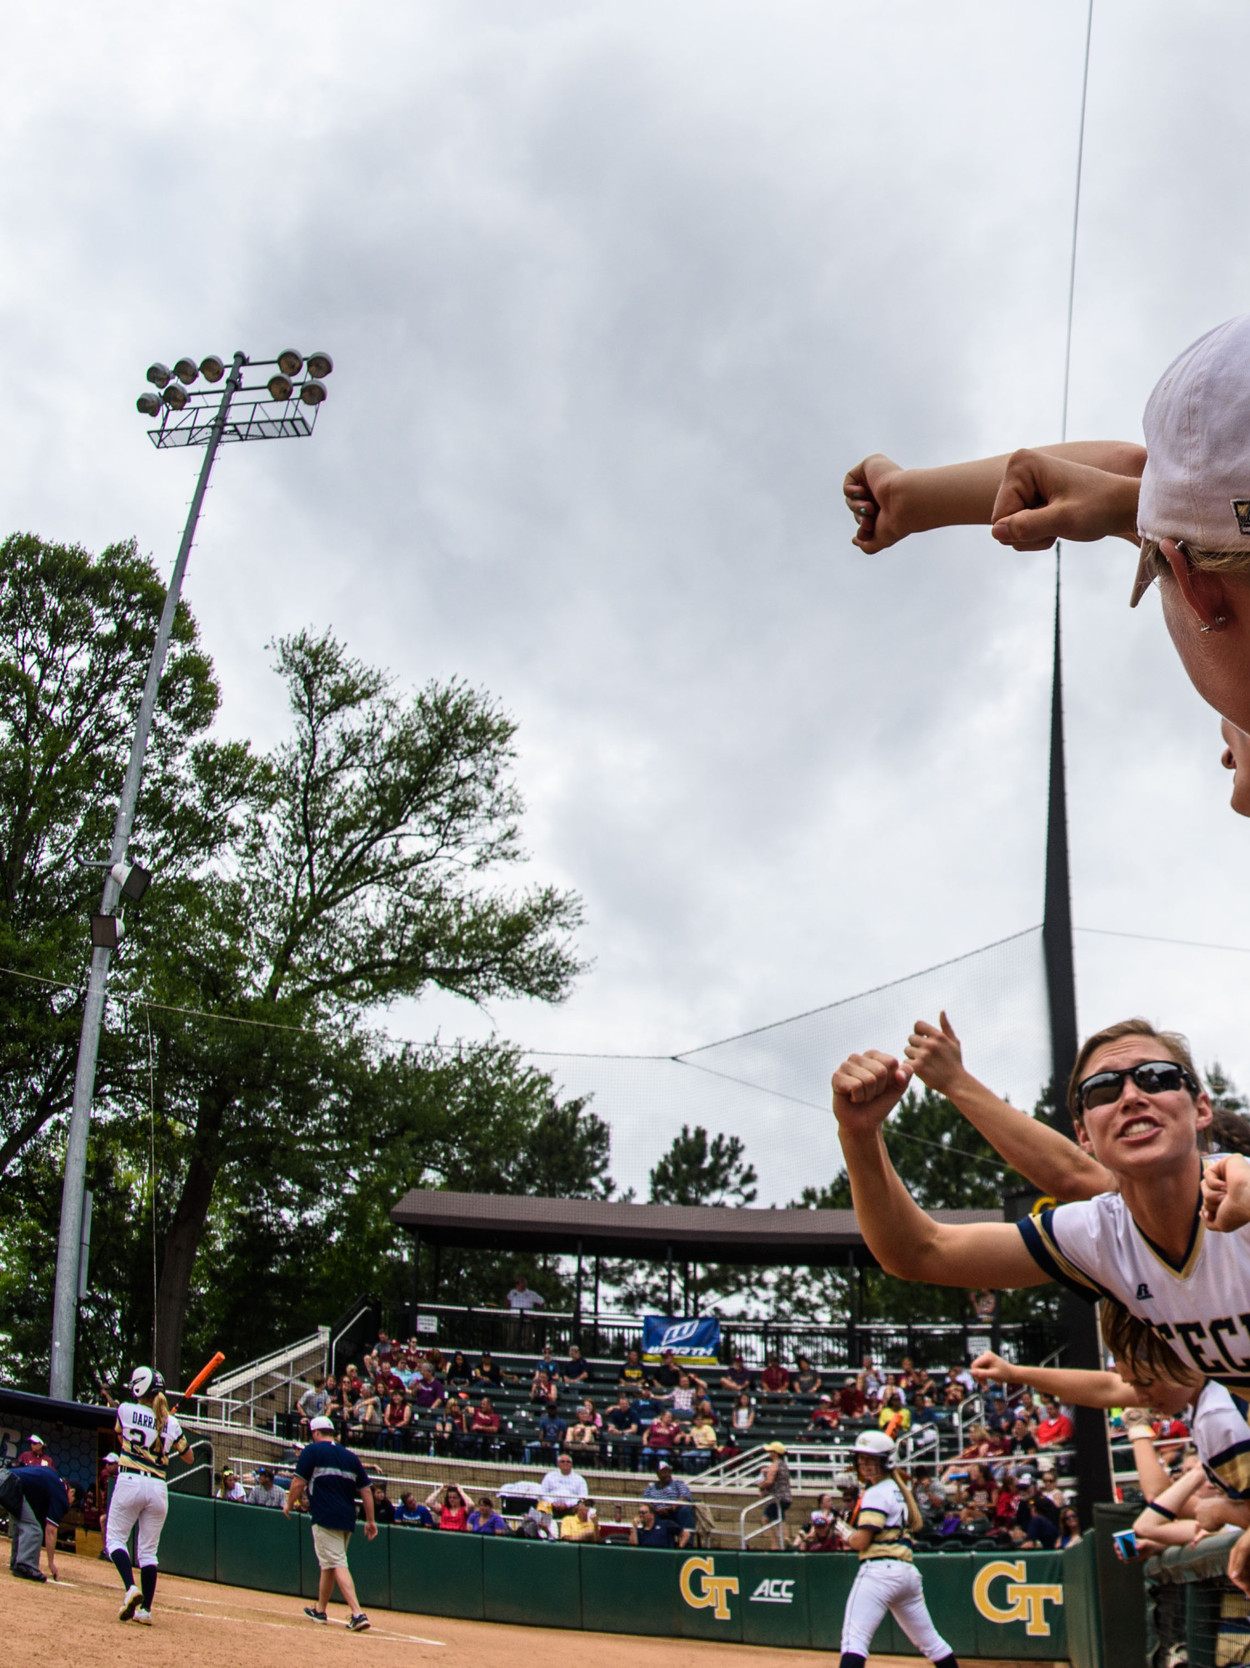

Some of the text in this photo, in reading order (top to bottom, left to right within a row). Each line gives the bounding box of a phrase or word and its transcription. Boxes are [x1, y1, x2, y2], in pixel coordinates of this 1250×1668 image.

[647, 1346, 713, 1356] WORTH
[132, 1411, 168, 1434] DARRAH
[679, 1556, 740, 1620] GT
[751, 1578, 796, 1600] ACC
[972, 1559, 1064, 1637] GT
